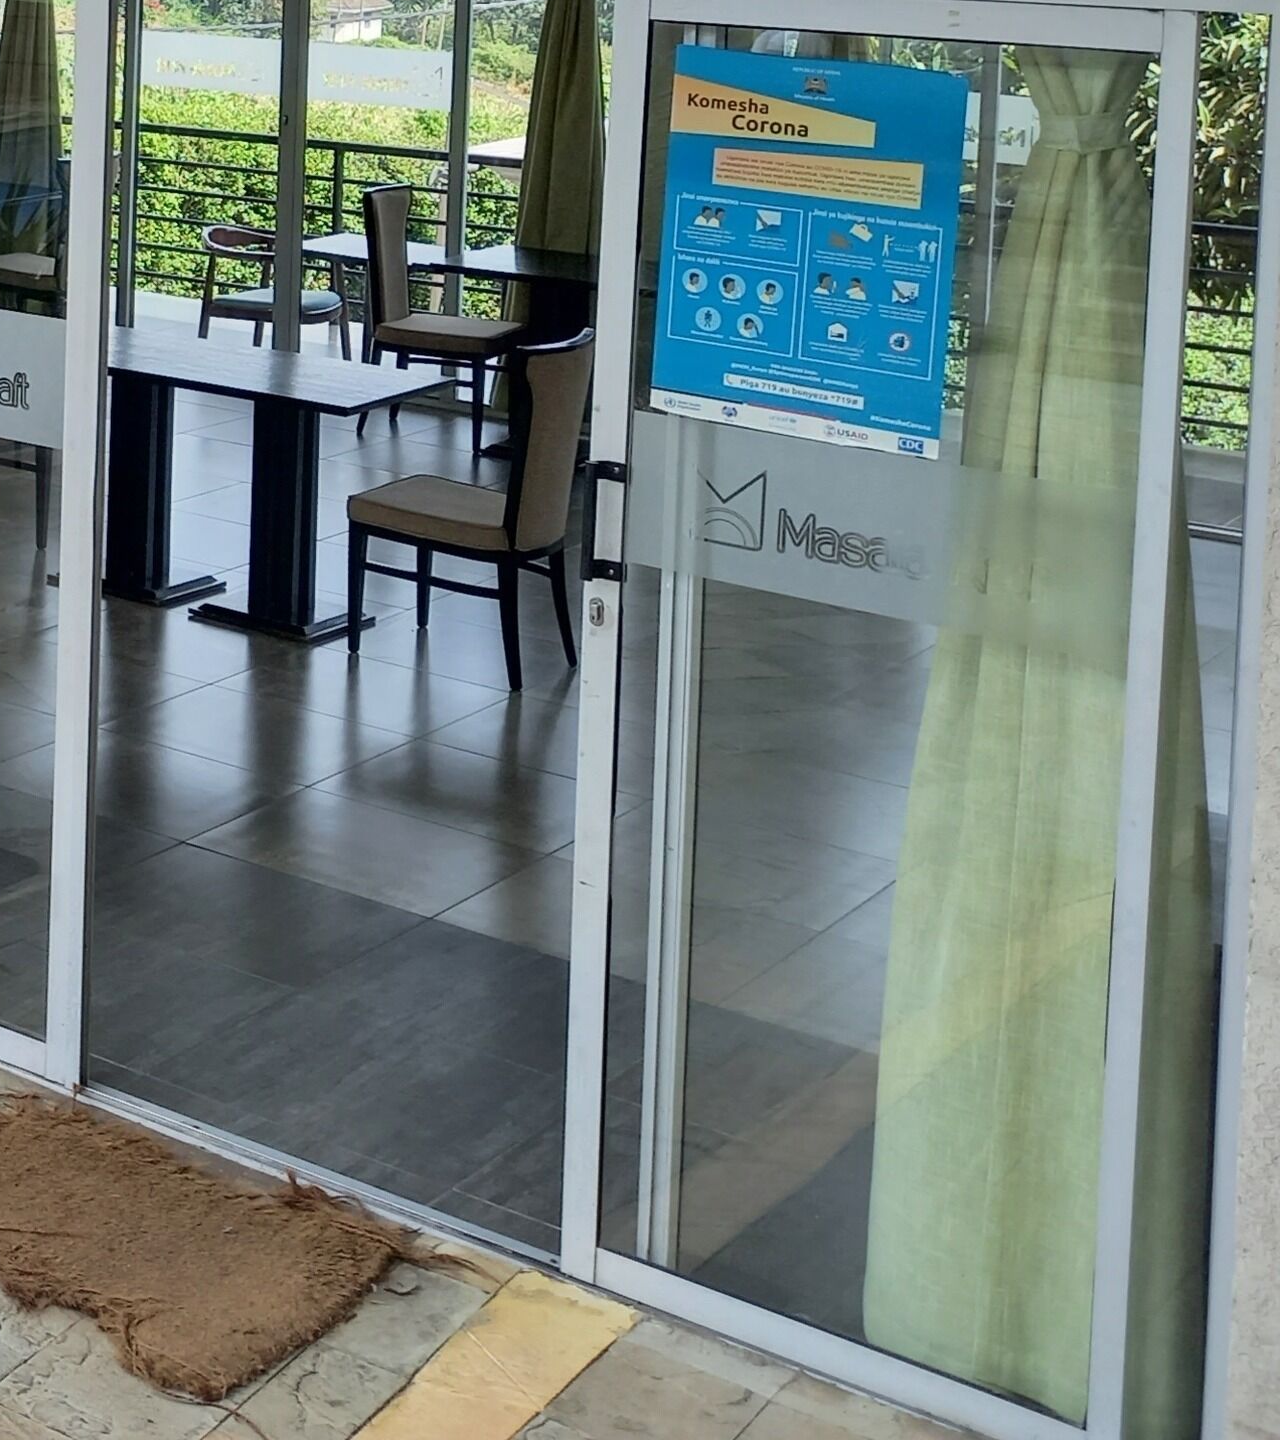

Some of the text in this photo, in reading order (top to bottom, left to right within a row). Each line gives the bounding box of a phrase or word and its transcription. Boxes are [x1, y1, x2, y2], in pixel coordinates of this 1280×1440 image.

[687, 93, 769, 115] Komesha
[732, 114, 809, 137] Corona
[740, 379, 759, 389] Piga
[761, 381, 777, 391] 719
[779, 385, 790, 393] au
[791, 386, 829, 401] bonyeza
[836, 427, 869, 441] USAID
[898, 438, 924, 452] CDC
[777, 508, 924, 580] Masa
